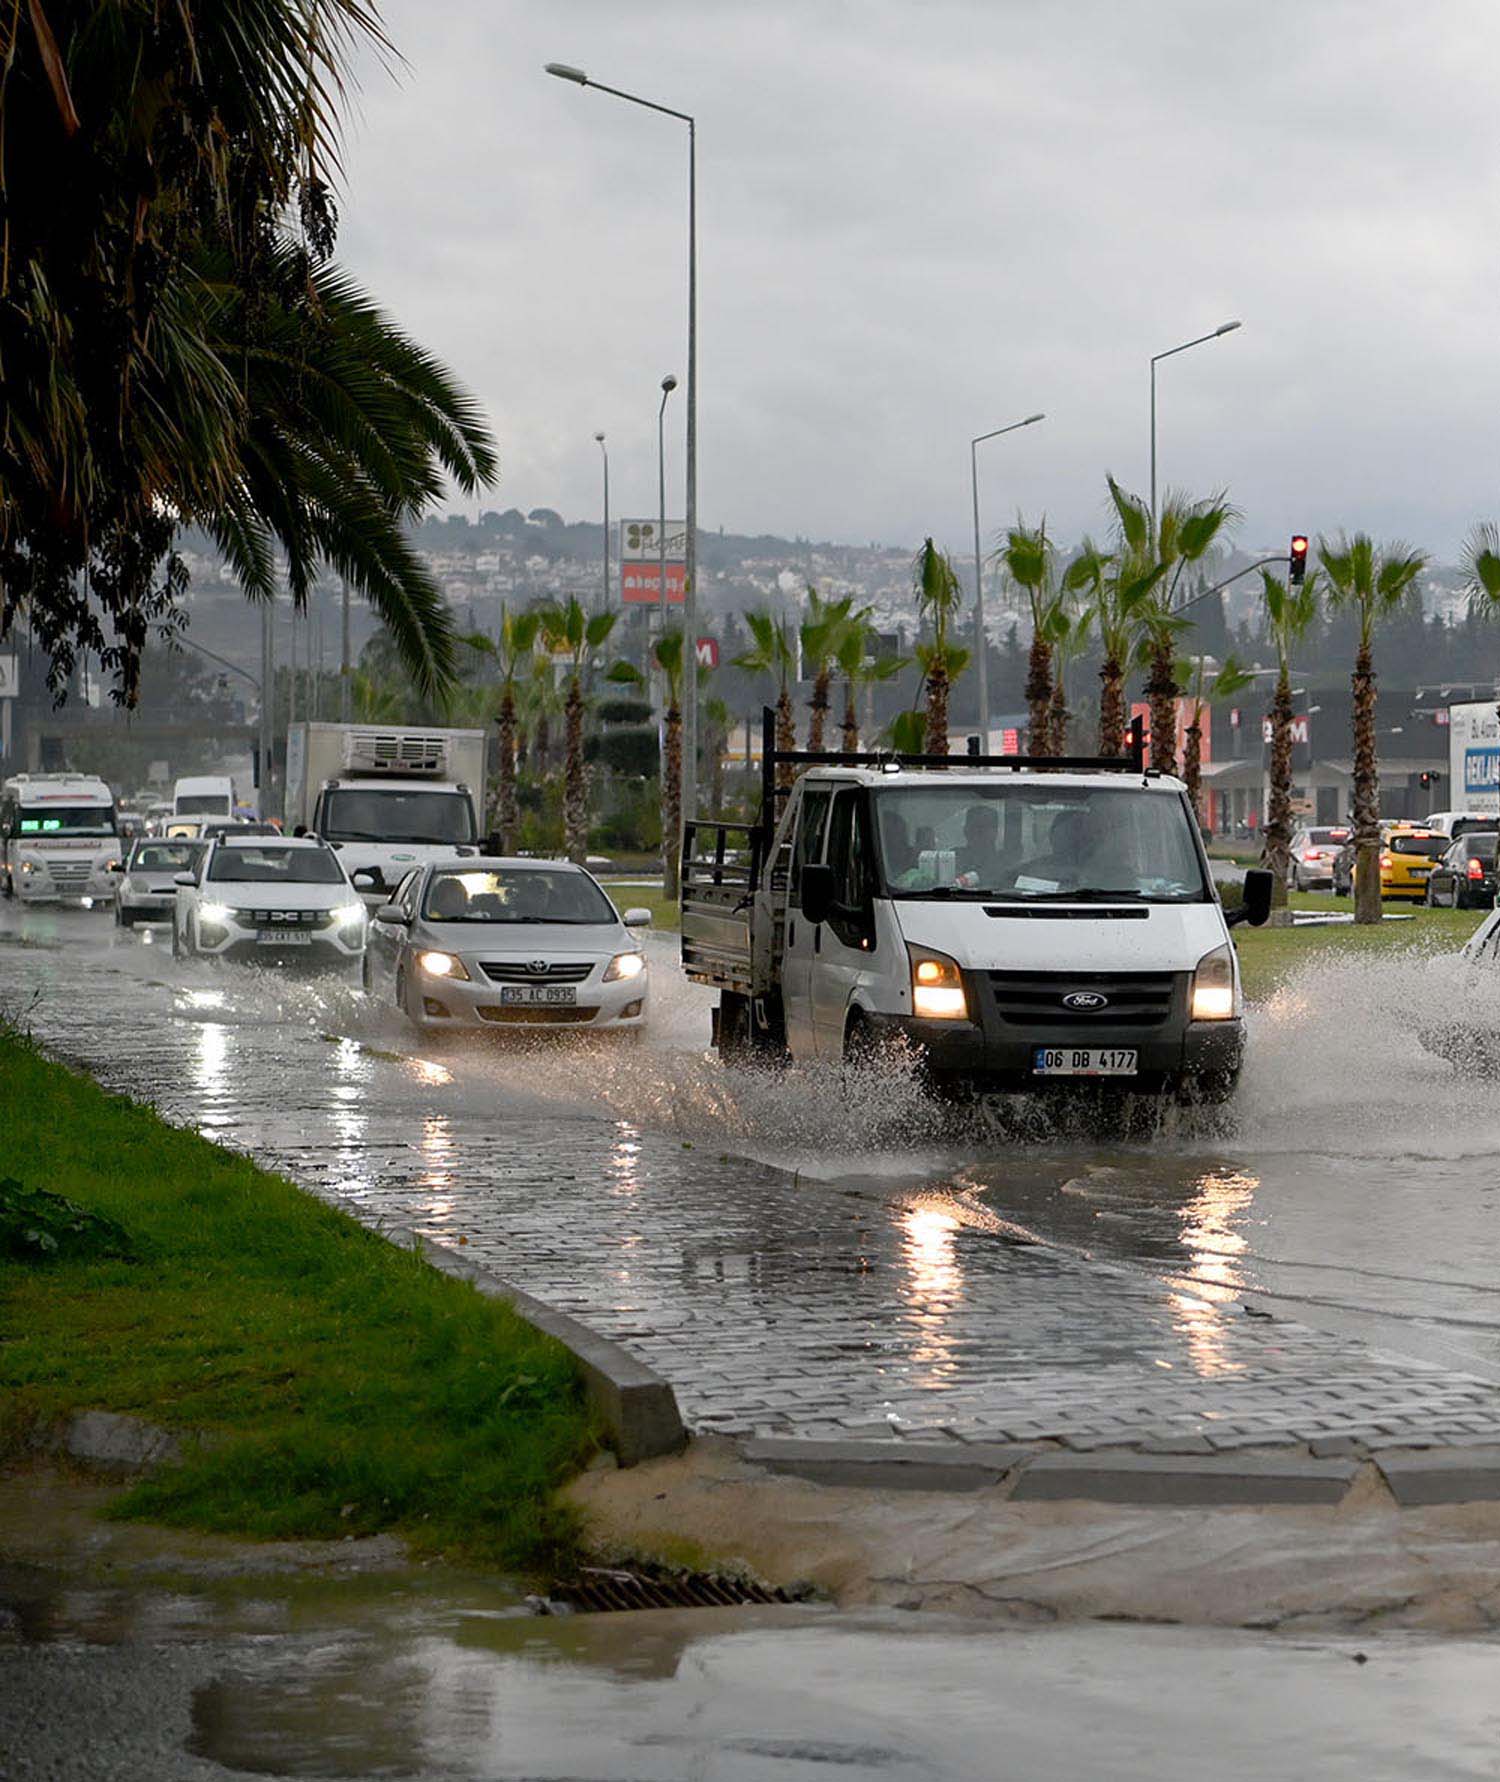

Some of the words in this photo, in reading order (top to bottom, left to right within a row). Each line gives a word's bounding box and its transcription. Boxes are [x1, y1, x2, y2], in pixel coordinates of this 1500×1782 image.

[511, 989, 523, 1000] 35
[529, 989, 543, 1001] AC
[1046, 1051, 1063, 1068] 06
[1072, 1051, 1090, 1068] DB
[1099, 1051, 1135, 1068] 4177
